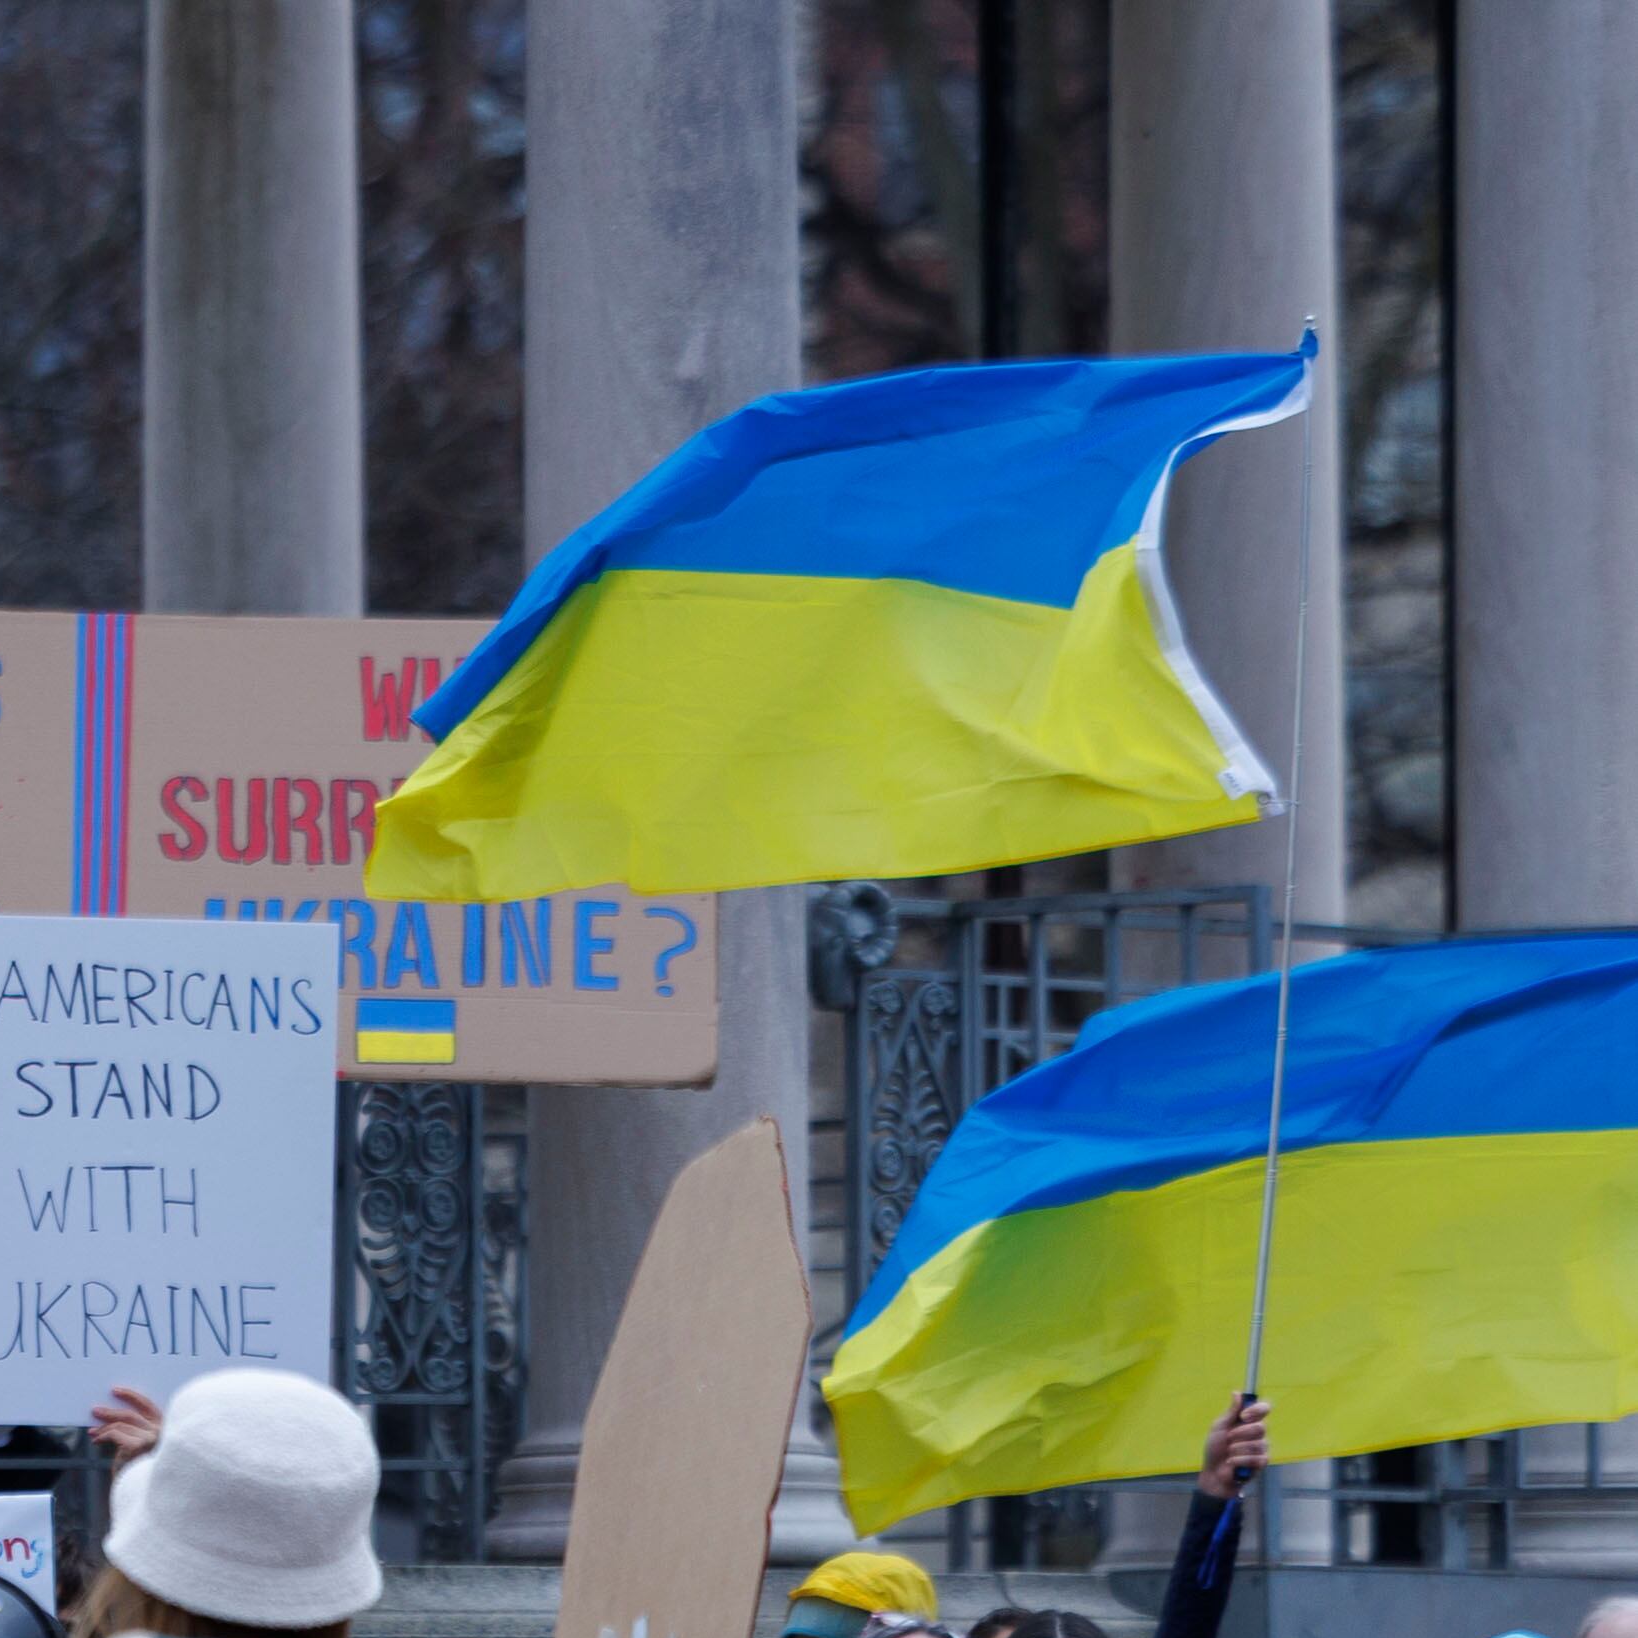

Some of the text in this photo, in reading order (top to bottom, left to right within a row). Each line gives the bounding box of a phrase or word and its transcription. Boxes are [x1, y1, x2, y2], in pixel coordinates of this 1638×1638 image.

[204, 898, 697, 998] RAINE?
[16, 1059, 221, 1121] STAND
[17, 1164, 200, 1237] WITH
